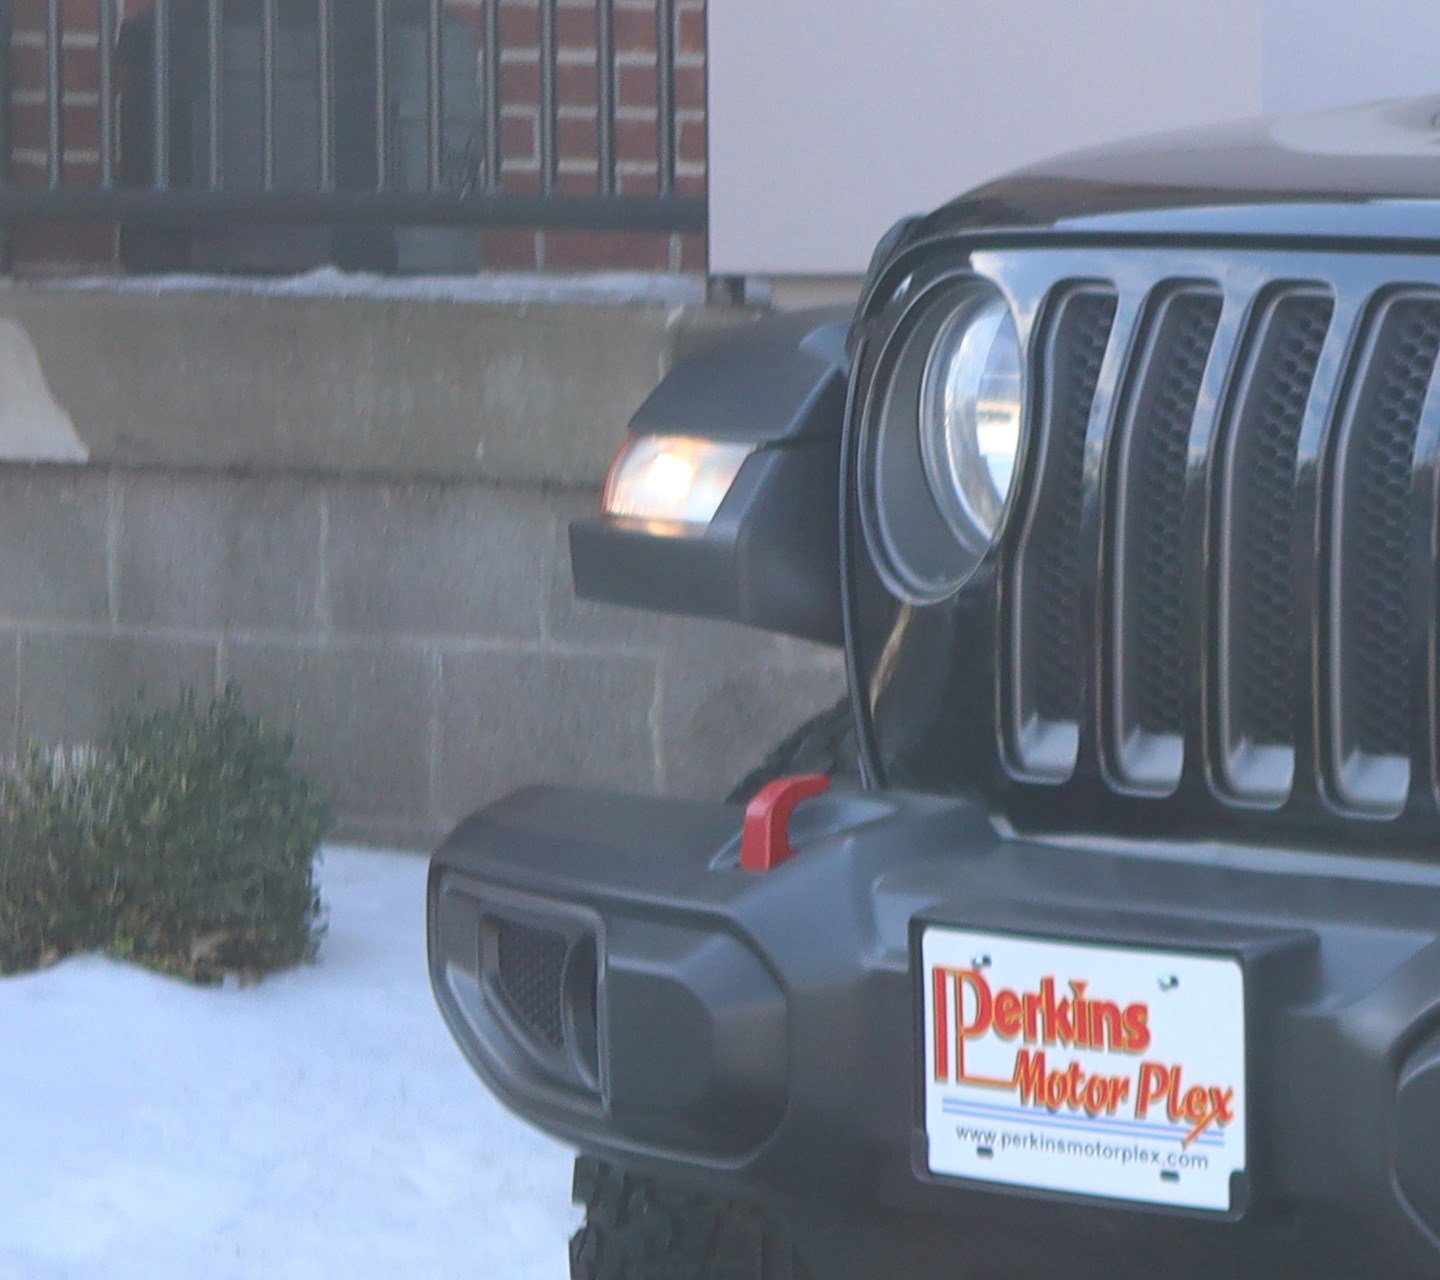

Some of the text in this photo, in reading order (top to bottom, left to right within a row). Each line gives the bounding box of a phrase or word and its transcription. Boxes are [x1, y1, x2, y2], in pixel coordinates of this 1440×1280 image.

[932, 966, 1152, 1083] Perkins
[1013, 1048, 1234, 1146] Motor Plex
[955, 1123, 1209, 1170] www.perkinsmotorplex.com
